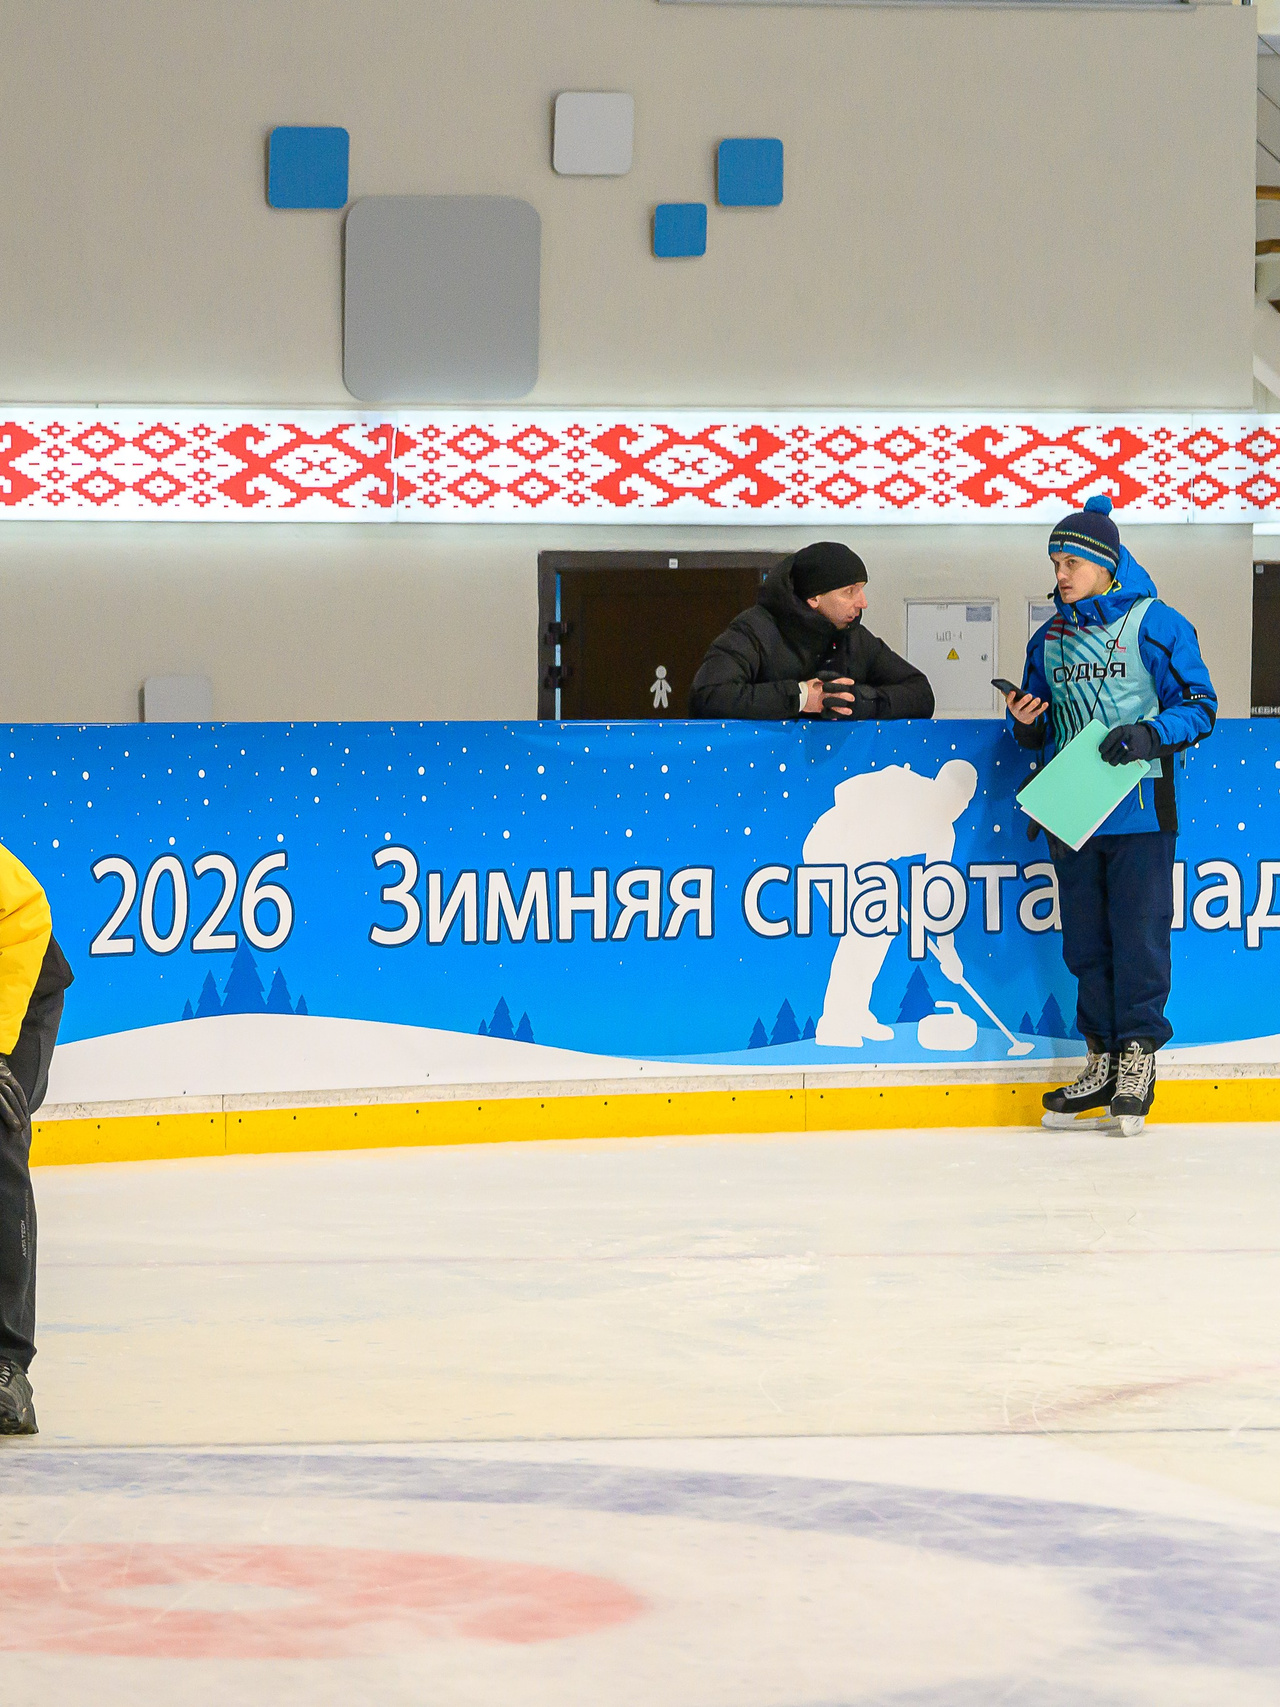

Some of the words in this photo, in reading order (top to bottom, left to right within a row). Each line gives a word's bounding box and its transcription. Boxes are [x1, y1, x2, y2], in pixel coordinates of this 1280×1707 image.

[1053, 662, 1126, 683] СУДЬЯ
[90, 851, 294, 955] 2026
[368, 845, 715, 947] Зимняя
[741, 860, 1280, 960] спартаад
